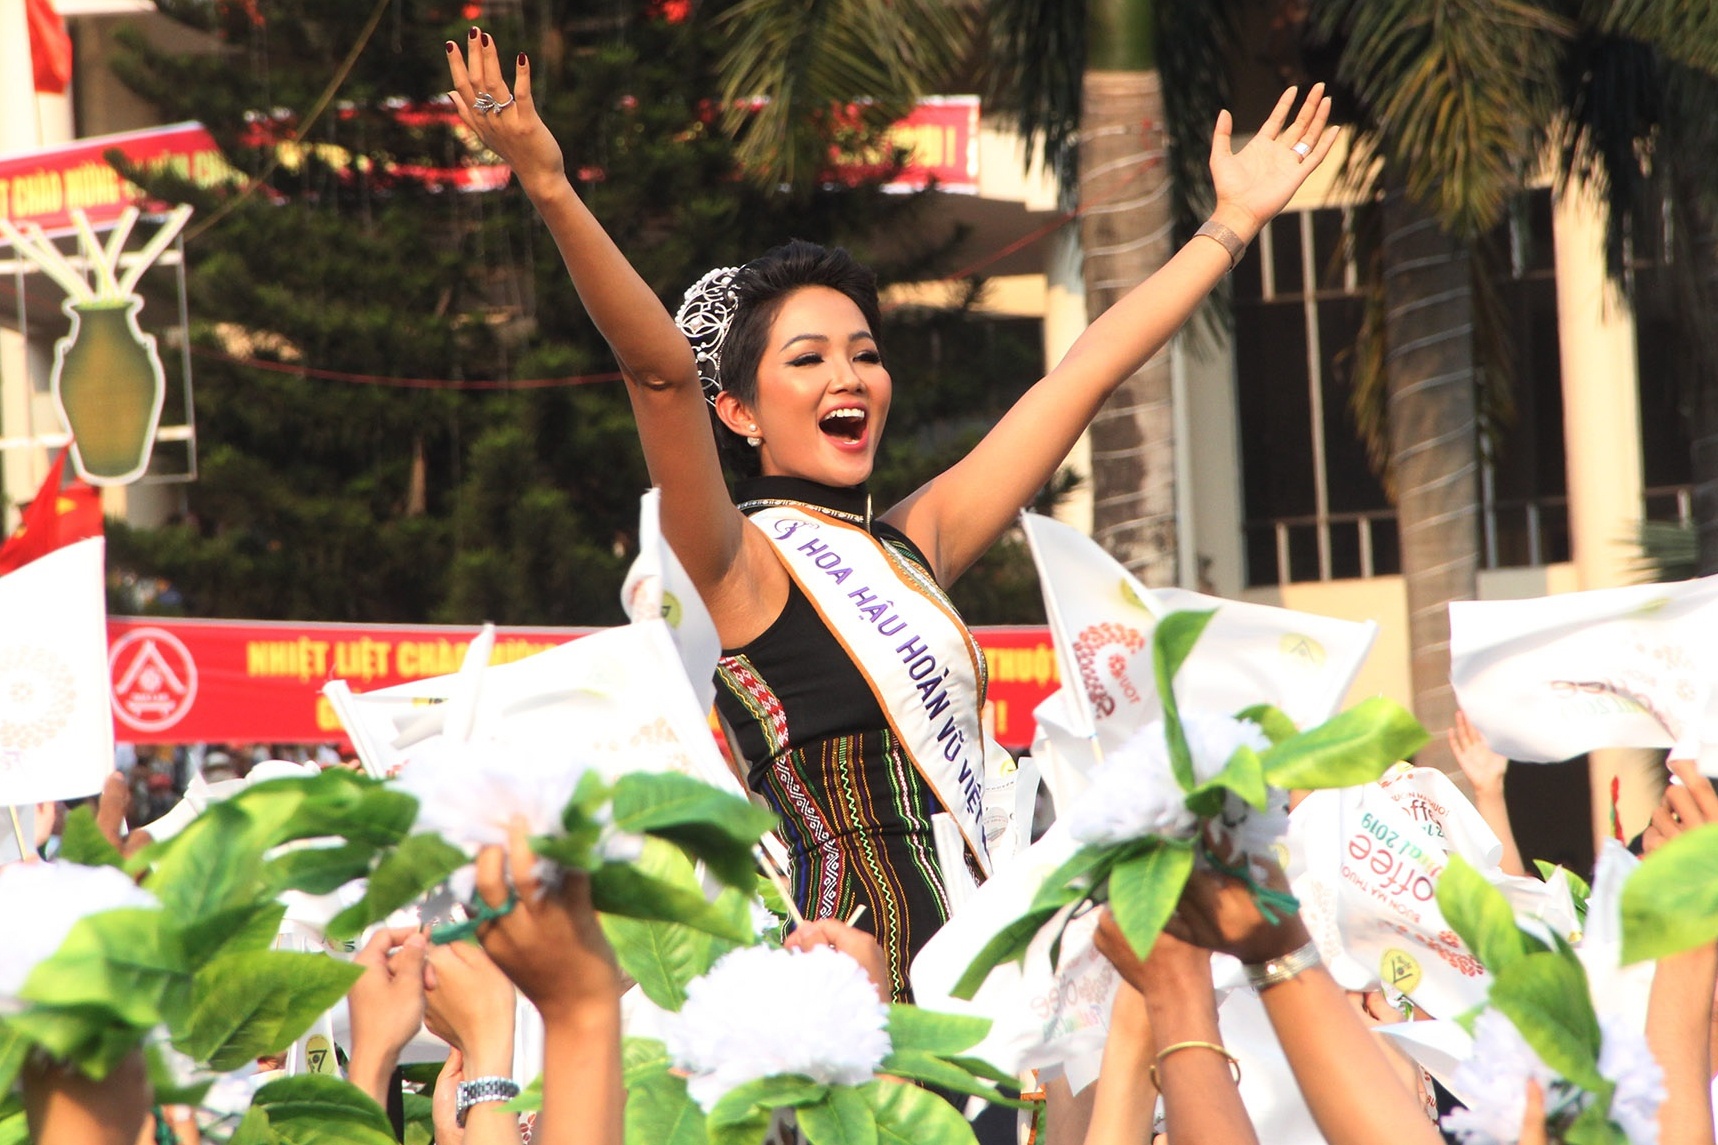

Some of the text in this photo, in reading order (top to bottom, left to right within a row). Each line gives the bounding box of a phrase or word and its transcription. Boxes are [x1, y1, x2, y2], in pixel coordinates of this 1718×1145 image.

[247, 636, 329, 684] NHIỆT
[334, 636, 390, 684] LIỆT
[797, 538, 853, 586] HOA
[847, 586, 908, 638] HẬU
[896, 635, 951, 721] HOÀN
[937, 716, 965, 762] VŨ
[1361, 812, 1400, 848] 2019
[1340, 864, 1369, 893] THUO
